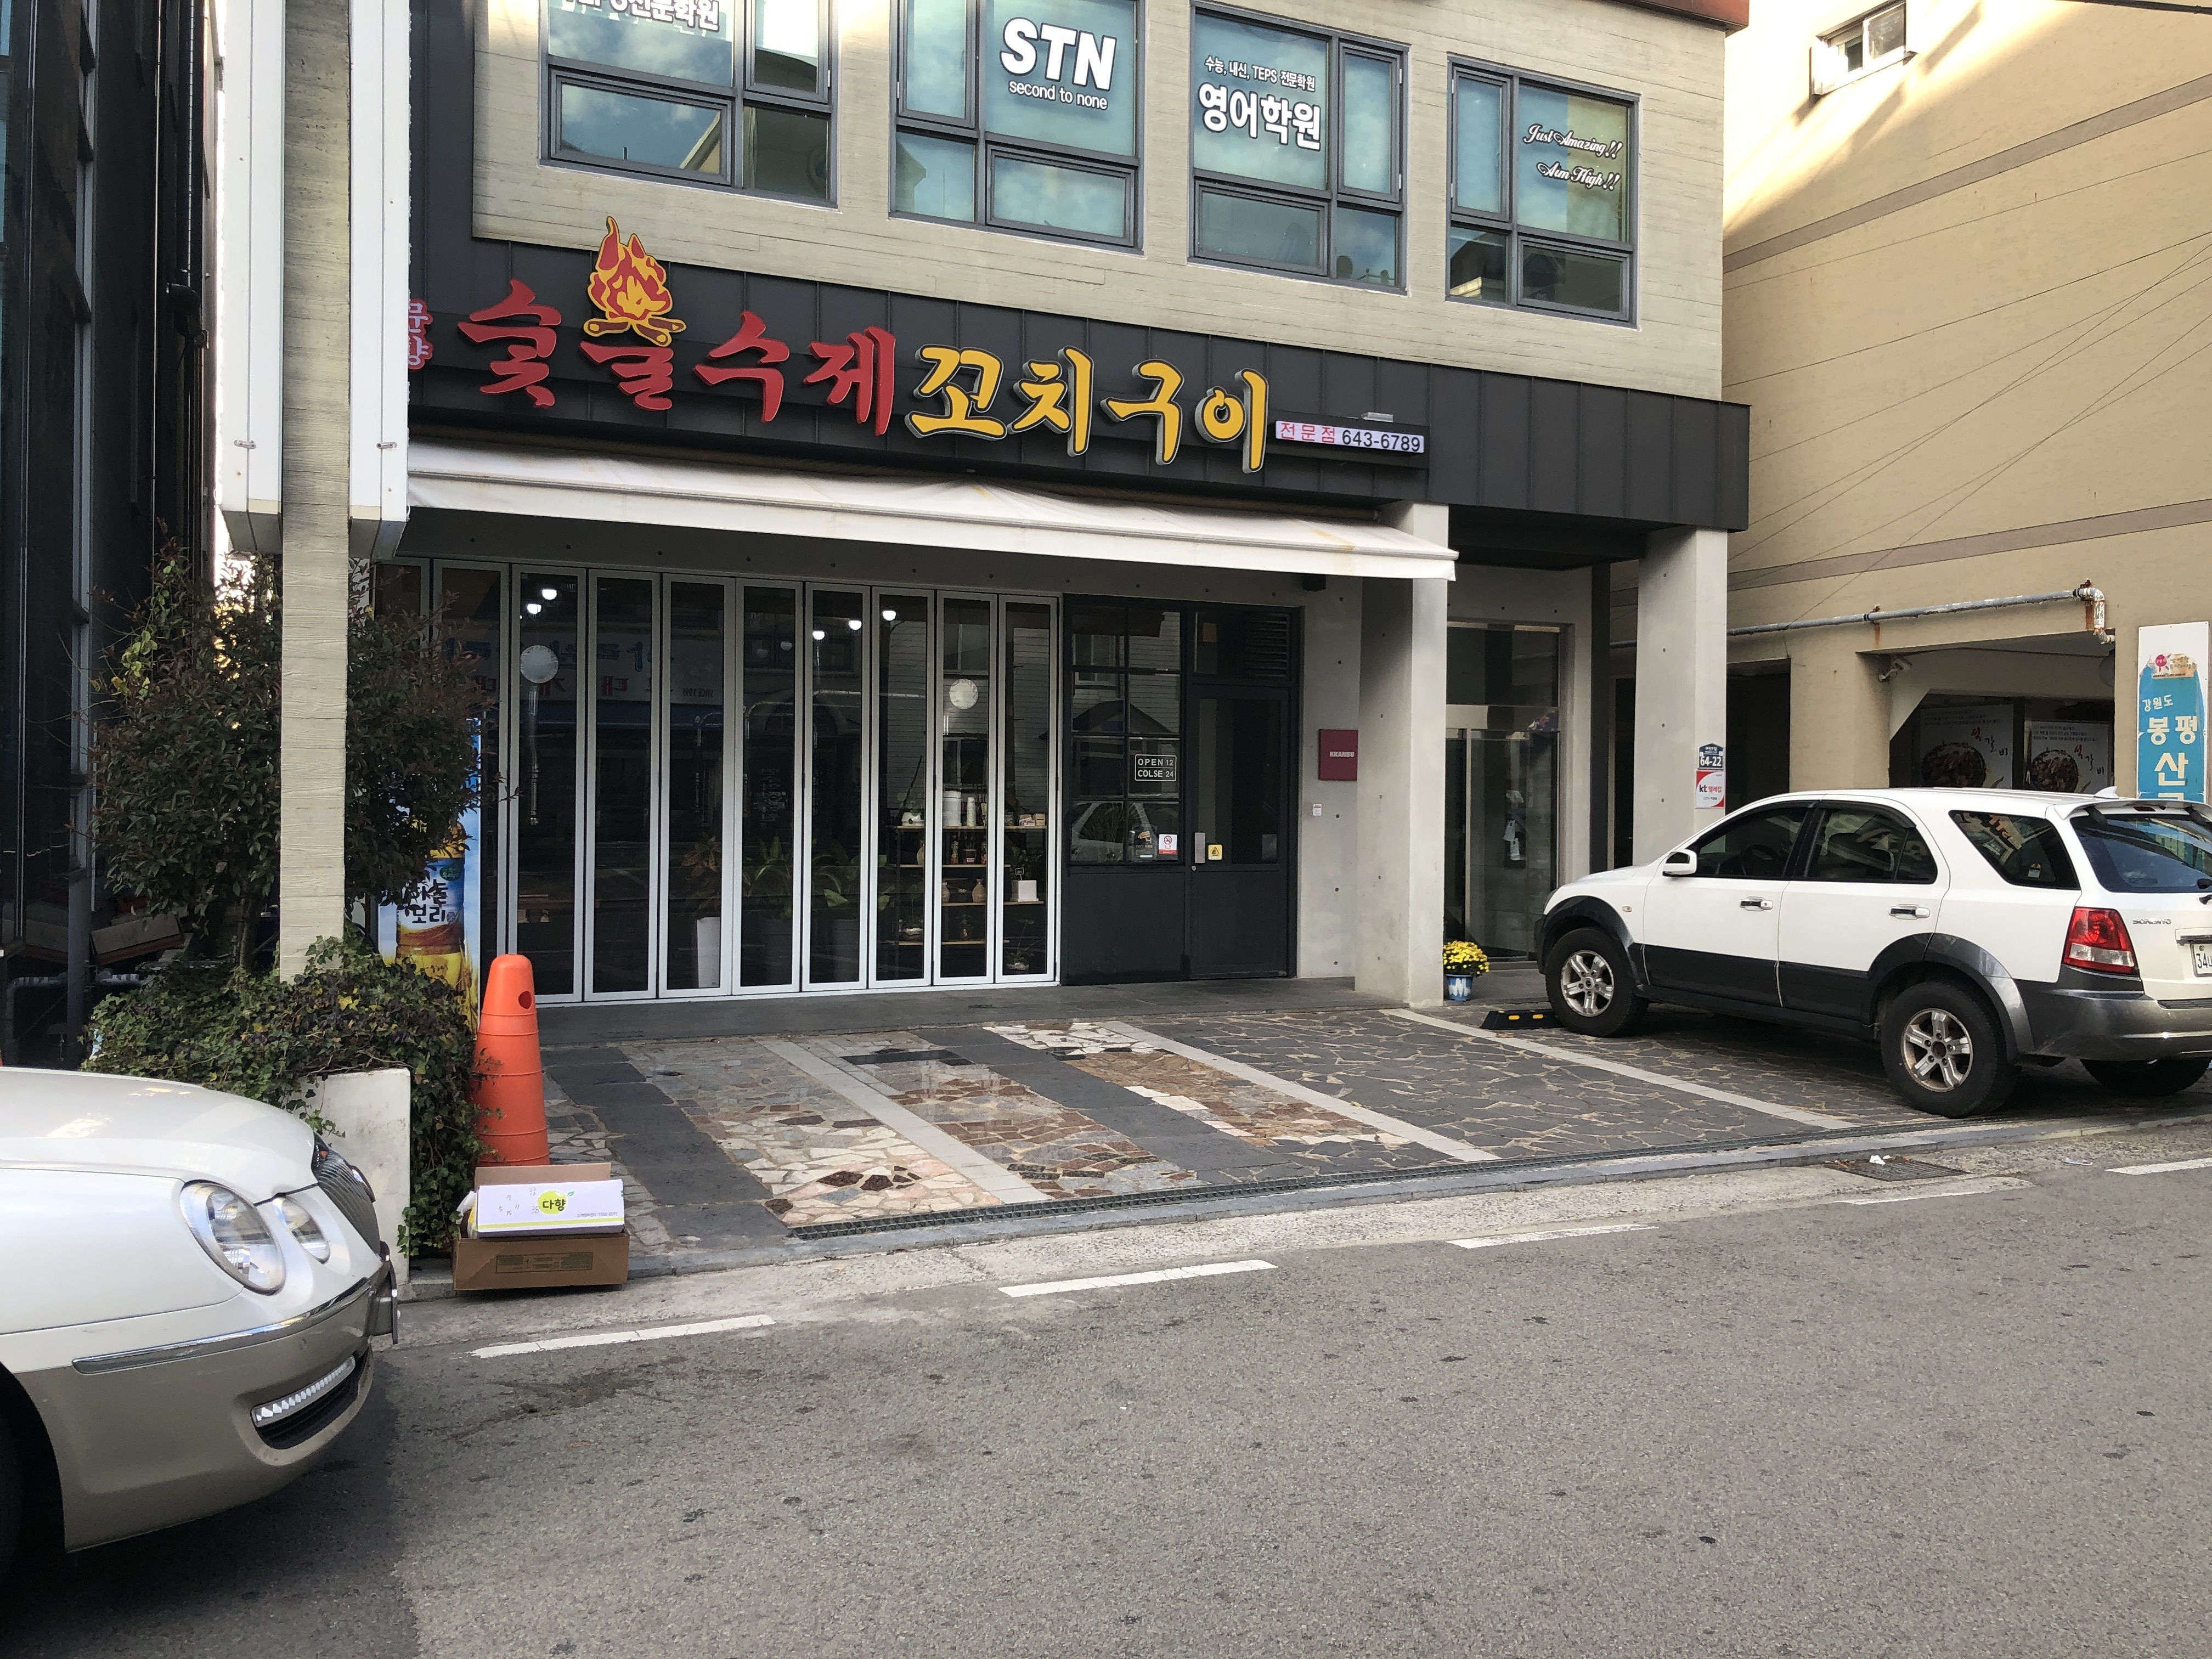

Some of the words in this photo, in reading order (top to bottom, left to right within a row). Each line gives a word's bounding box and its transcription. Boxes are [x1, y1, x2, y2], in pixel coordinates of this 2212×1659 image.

[1001, 17, 1117, 91] STN
[1205, 55, 1227, 76] 수능,
[1229, 60, 1250, 81] 내신,
[1251, 65, 1278, 83] TEPS
[1279, 70, 1316, 92] 전문학원
[1008, 81, 1056, 101] second
[1059, 87, 1074, 104] to
[1076, 93, 1108, 110] none
[1198, 82, 1322, 151] 영어학원
[1523, 123, 1555, 144] Just
[1536, 161, 1571, 181] Aim
[904, 343, 1268, 474] 꼬치구이
[1280, 422, 1335, 444] 전문점
[1342, 430, 1420, 453] 643-6789
[2141, 694, 2173, 712] 강원도
[2147, 716, 2198, 746] 봉평
[1137, 758, 1164, 766] OPEN
[1700, 755, 1722, 766] 64-22
[1137, 769, 1163, 778] COLSE
[1699, 785, 1707, 793] kt
[411, 904, 445, 924] 보리
[542, 1199, 566, 1211] 다향
